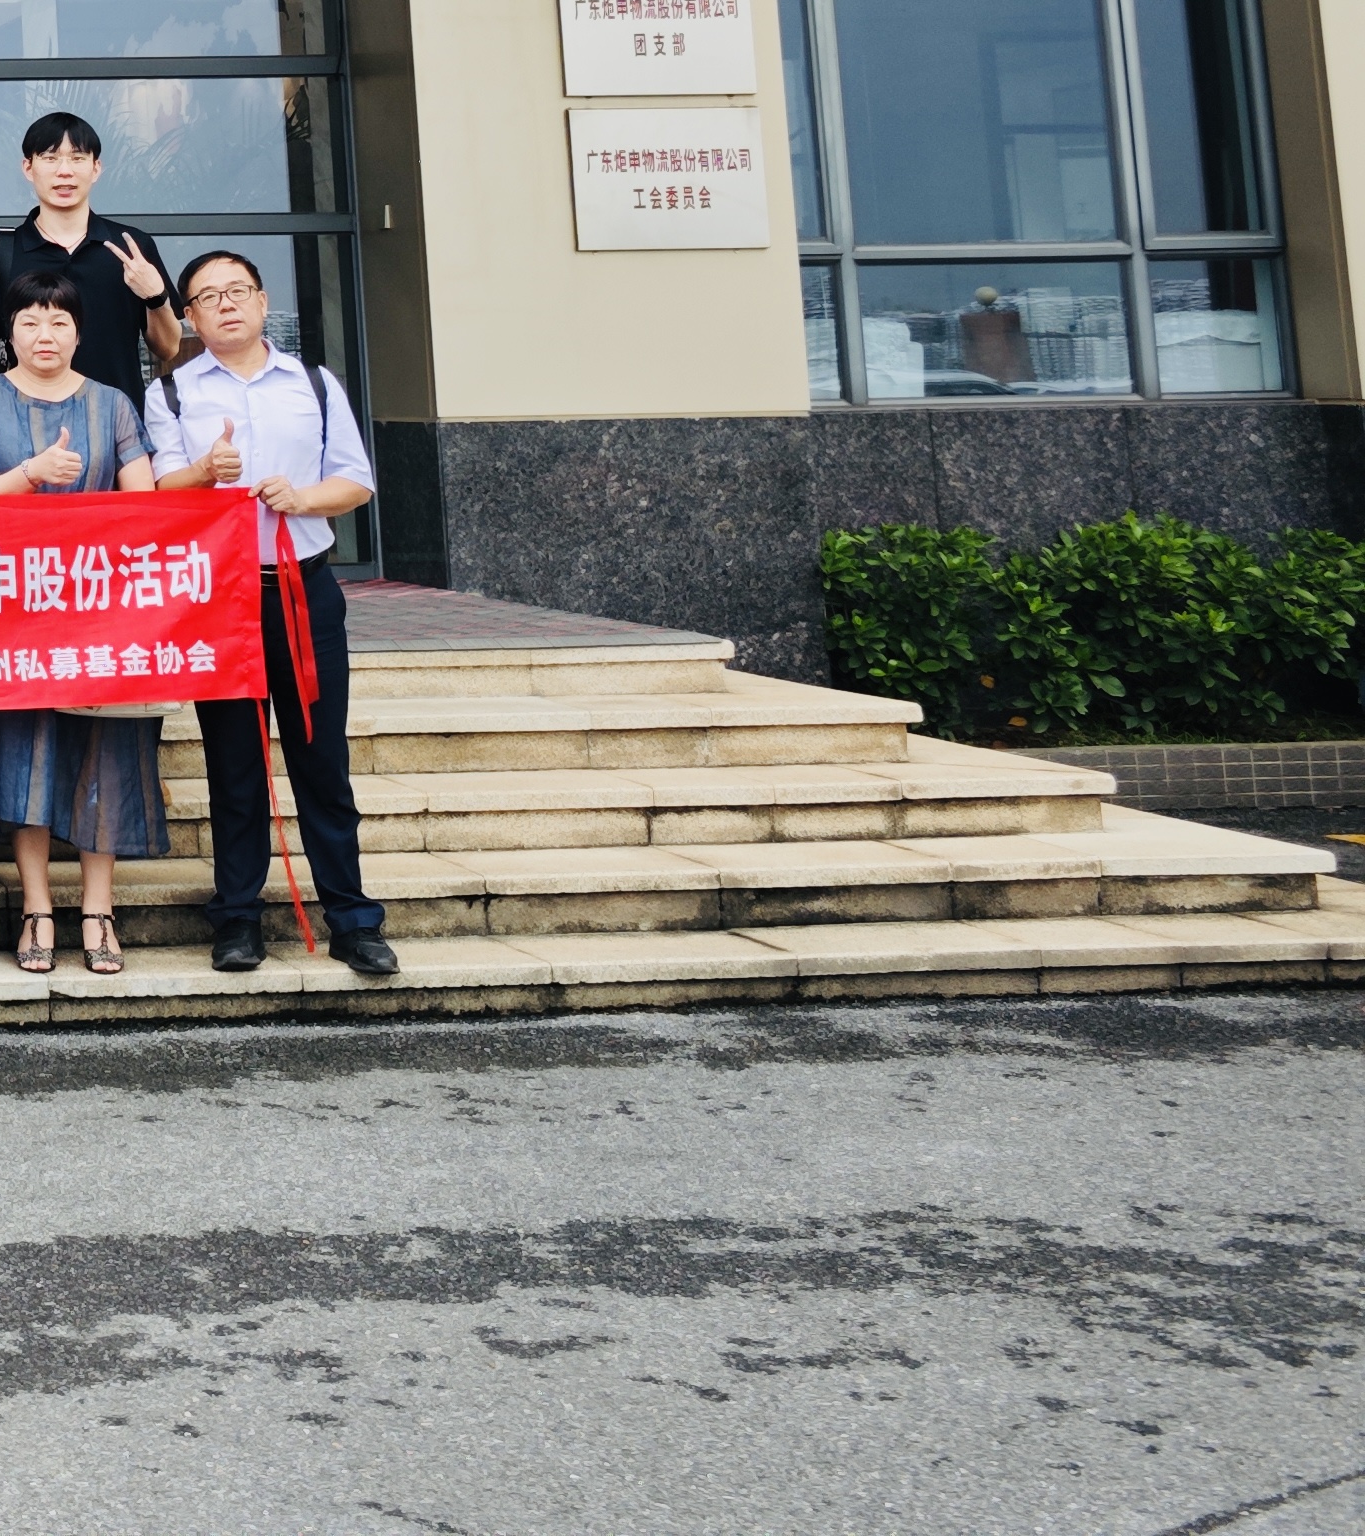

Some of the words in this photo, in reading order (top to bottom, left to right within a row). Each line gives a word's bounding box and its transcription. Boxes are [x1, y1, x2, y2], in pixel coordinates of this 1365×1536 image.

[633, 32, 686, 57] 团支部
[587, 148, 753, 173] 广东炬申物流股份有限公司
[633, 185, 712, 210] 工会委员会
